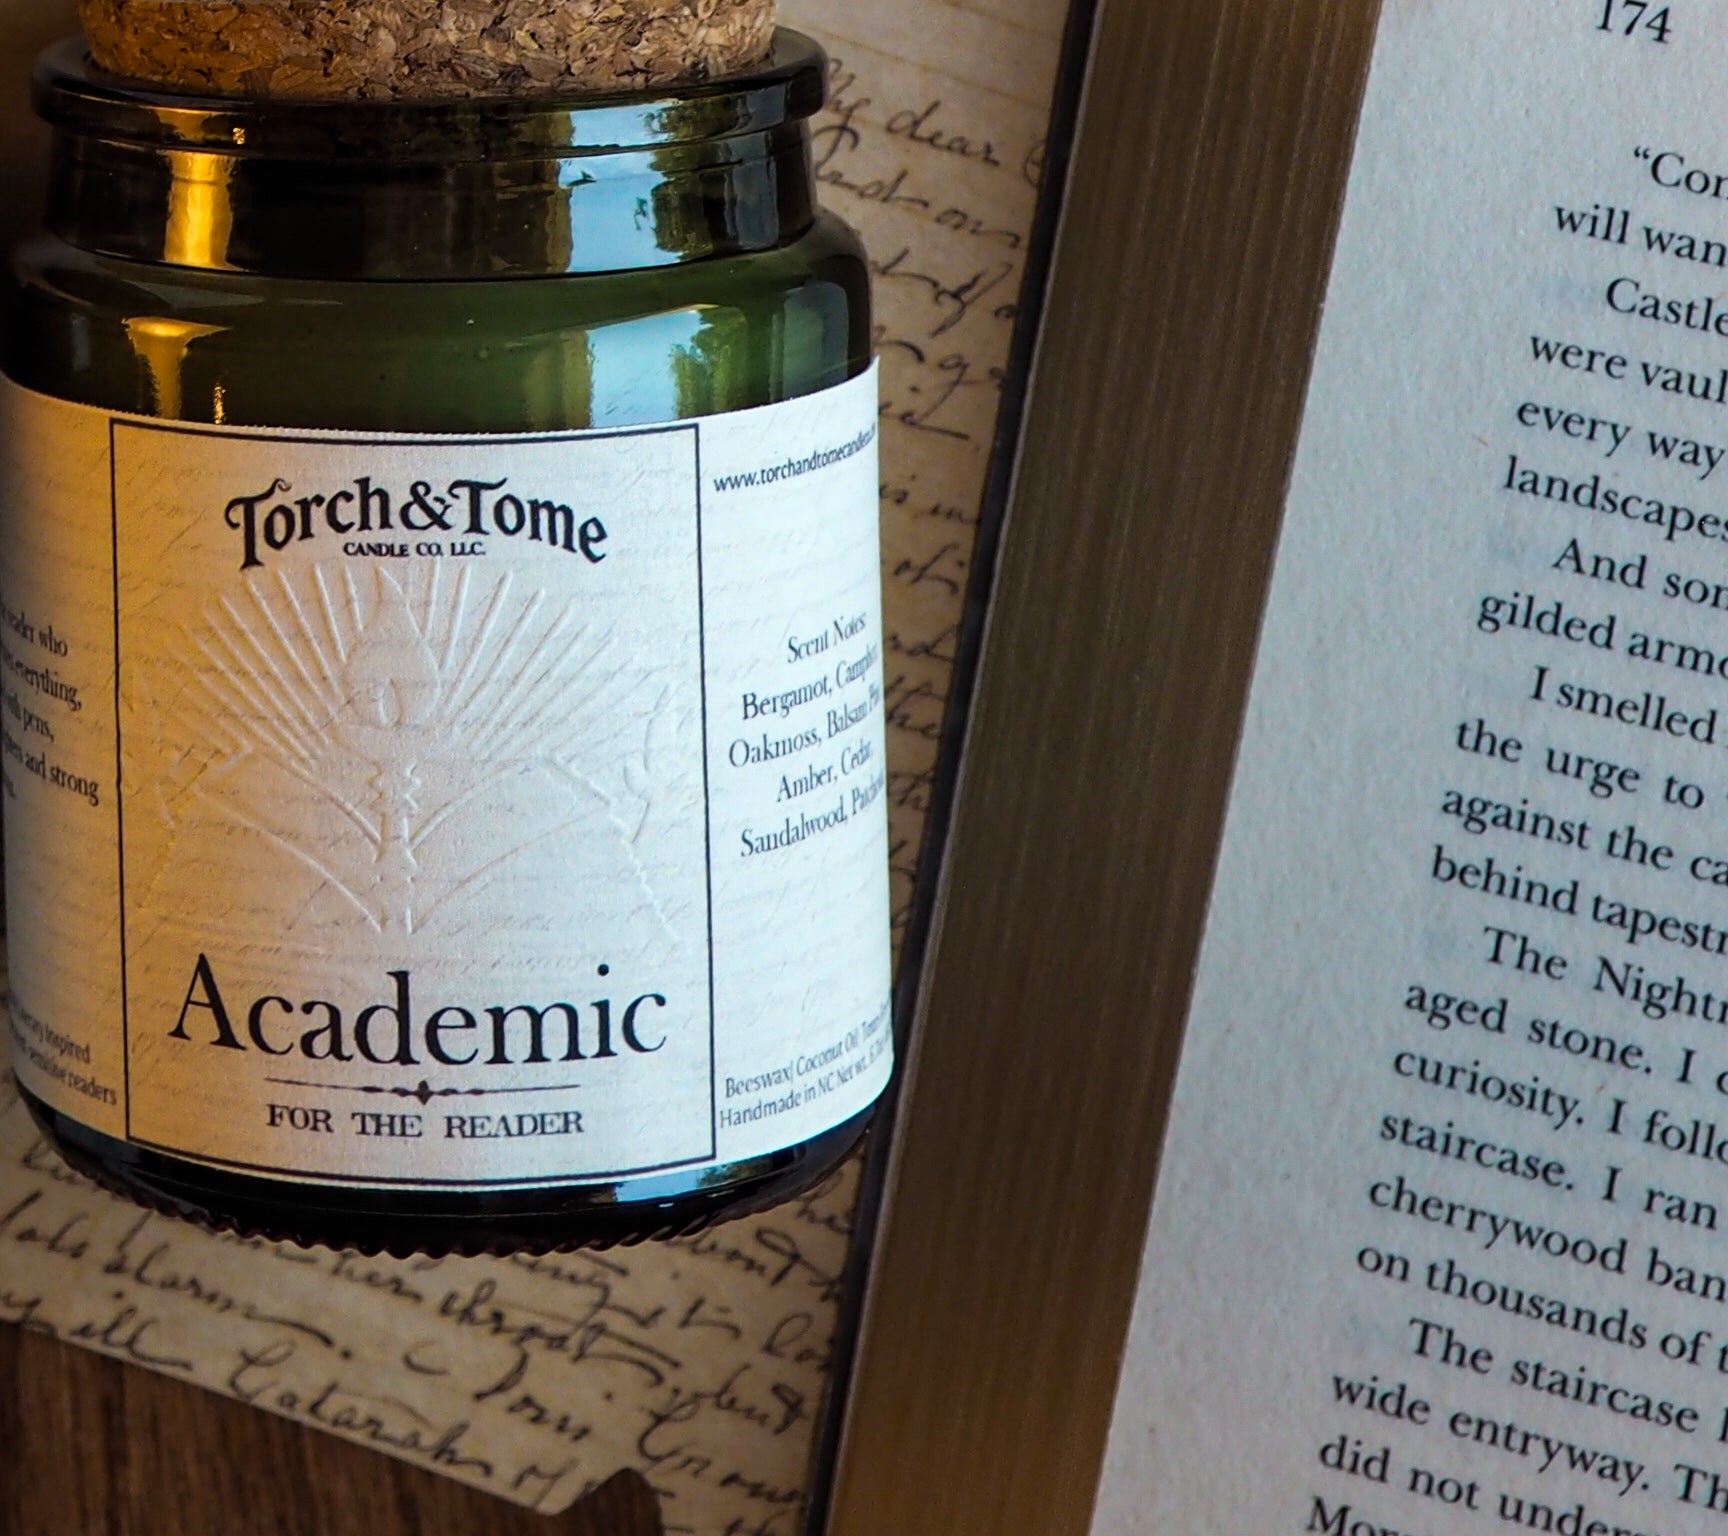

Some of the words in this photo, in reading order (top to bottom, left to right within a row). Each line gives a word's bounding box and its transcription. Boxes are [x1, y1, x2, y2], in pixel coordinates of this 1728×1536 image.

[1554, 203, 1630, 244] will
[1641, 224, 1728, 267] wan
[1606, 277, 1728, 337] Castle
[1530, 334, 1627, 380] were
[1640, 361, 1728, 405] vaul
[1516, 401, 1632, 457] every
[1647, 430, 1726, 481] way
[224, 476, 609, 571] Torch&Tome
[343, 542, 409, 557] CANDLE
[416, 542, 444, 557] CO.
[450, 542, 485, 557] LLC.
[1551, 537, 1647, 590] And
[38, 625, 68, 657] who
[787, 631, 829, 664] Scent
[1476, 591, 1616, 651] gilded
[742, 675, 833, 720] Bergamot,
[1529, 665, 1550, 702] I
[1555, 682, 1718, 746] smelled
[728, 726, 822, 767] Oakmoss,
[1456, 718, 1523, 762] the
[1545, 745, 1640, 800] urge
[1663, 774, 1705, 811] to
[50, 765, 99, 807] strong
[776, 762, 838, 802] Amber,
[741, 795, 847, 858] Sandalwood,
[1441, 789, 1592, 851] against
[1606, 825, 1674, 870] the
[1431, 844, 1579, 916] behind
[1484, 926, 1568, 981] The
[167, 952, 667, 1065] Academic
[1405, 984, 1508, 1034] aged
[1527, 1015, 1653, 1075] stone.
[1677, 1048, 1696, 1085] I
[796, 1041, 843, 1076] Coconut
[265, 1103, 335, 1133] FOR
[351, 1111, 422, 1138] THE
[444, 1110, 584, 1139] READER
[720, 1088, 801, 1129] Handmade
[804, 1085, 816, 1104] in
[1393, 1051, 1583, 1132] curiosity.
[1607, 1098, 1627, 1134] I
[1379, 1114, 1573, 1190] staircase.
[1601, 1166, 1623, 1202] I
[1643, 1185, 1718, 1230] ran
[1369, 1176, 1628, 1275] cherrywood
[1647, 1248, 1728, 1303] ban
[1357, 1245, 1410, 1283] on
[1425, 1259, 1648, 1350] thousands
[1659, 1330, 1710, 1366] of
[1409, 1317, 1494, 1375] The
[1510, 1360, 1699, 1434] staircase
[1331, 1374, 1431, 1425] wide
[1449, 1410, 1650, 1497] entryway.
[1319, 1434, 1391, 1484] did
[1408, 1465, 1480, 1511] not
